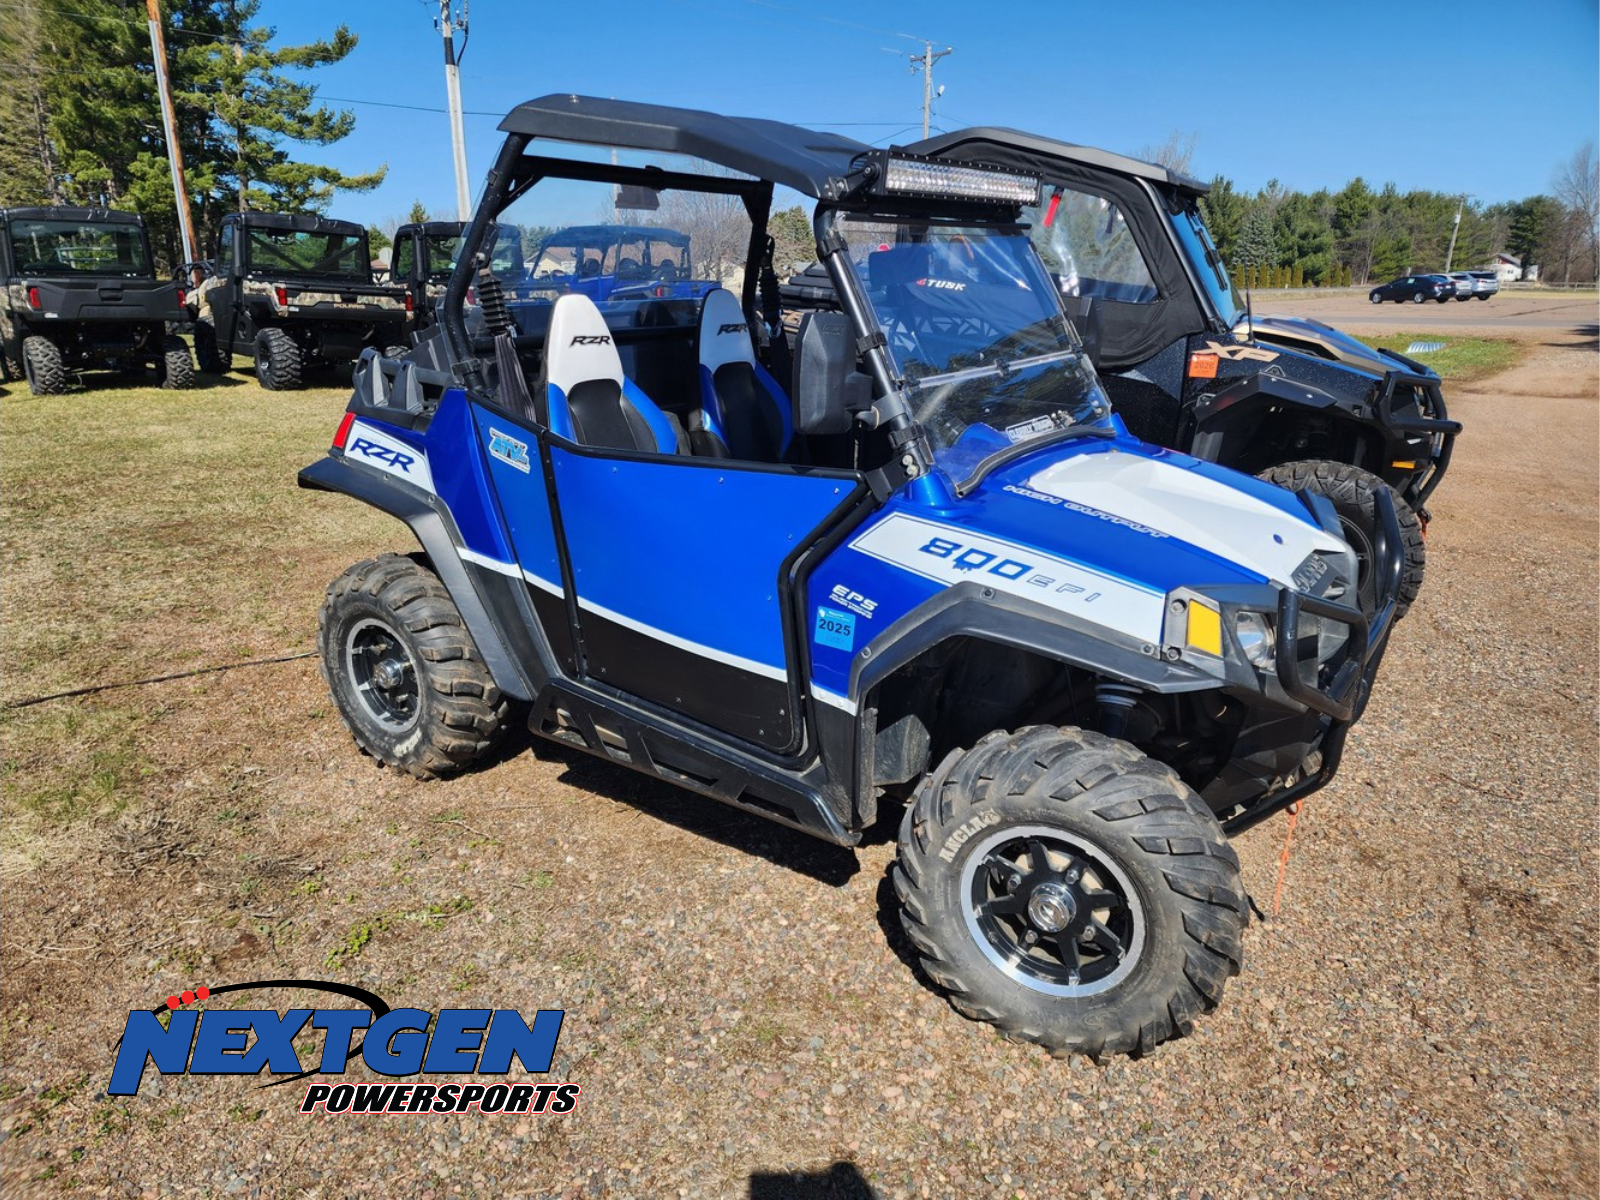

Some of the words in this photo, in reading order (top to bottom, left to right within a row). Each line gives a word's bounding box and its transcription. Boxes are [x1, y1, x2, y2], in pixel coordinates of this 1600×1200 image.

[927, 279, 967, 291] TUSK
[569, 335, 611, 347] RZR
[717, 323, 748, 336] RZR
[1191, 340, 1280, 363] XP
[350, 437, 415, 474] RZR
[1064, 501, 1170, 539] OUTPUT
[918, 536, 1035, 581] 800
[1026, 573, 1102, 603] EFI
[831, 583, 879, 612] EPS
[818, 618, 851, 637] 2025
[938, 815, 988, 864] ANCLA
